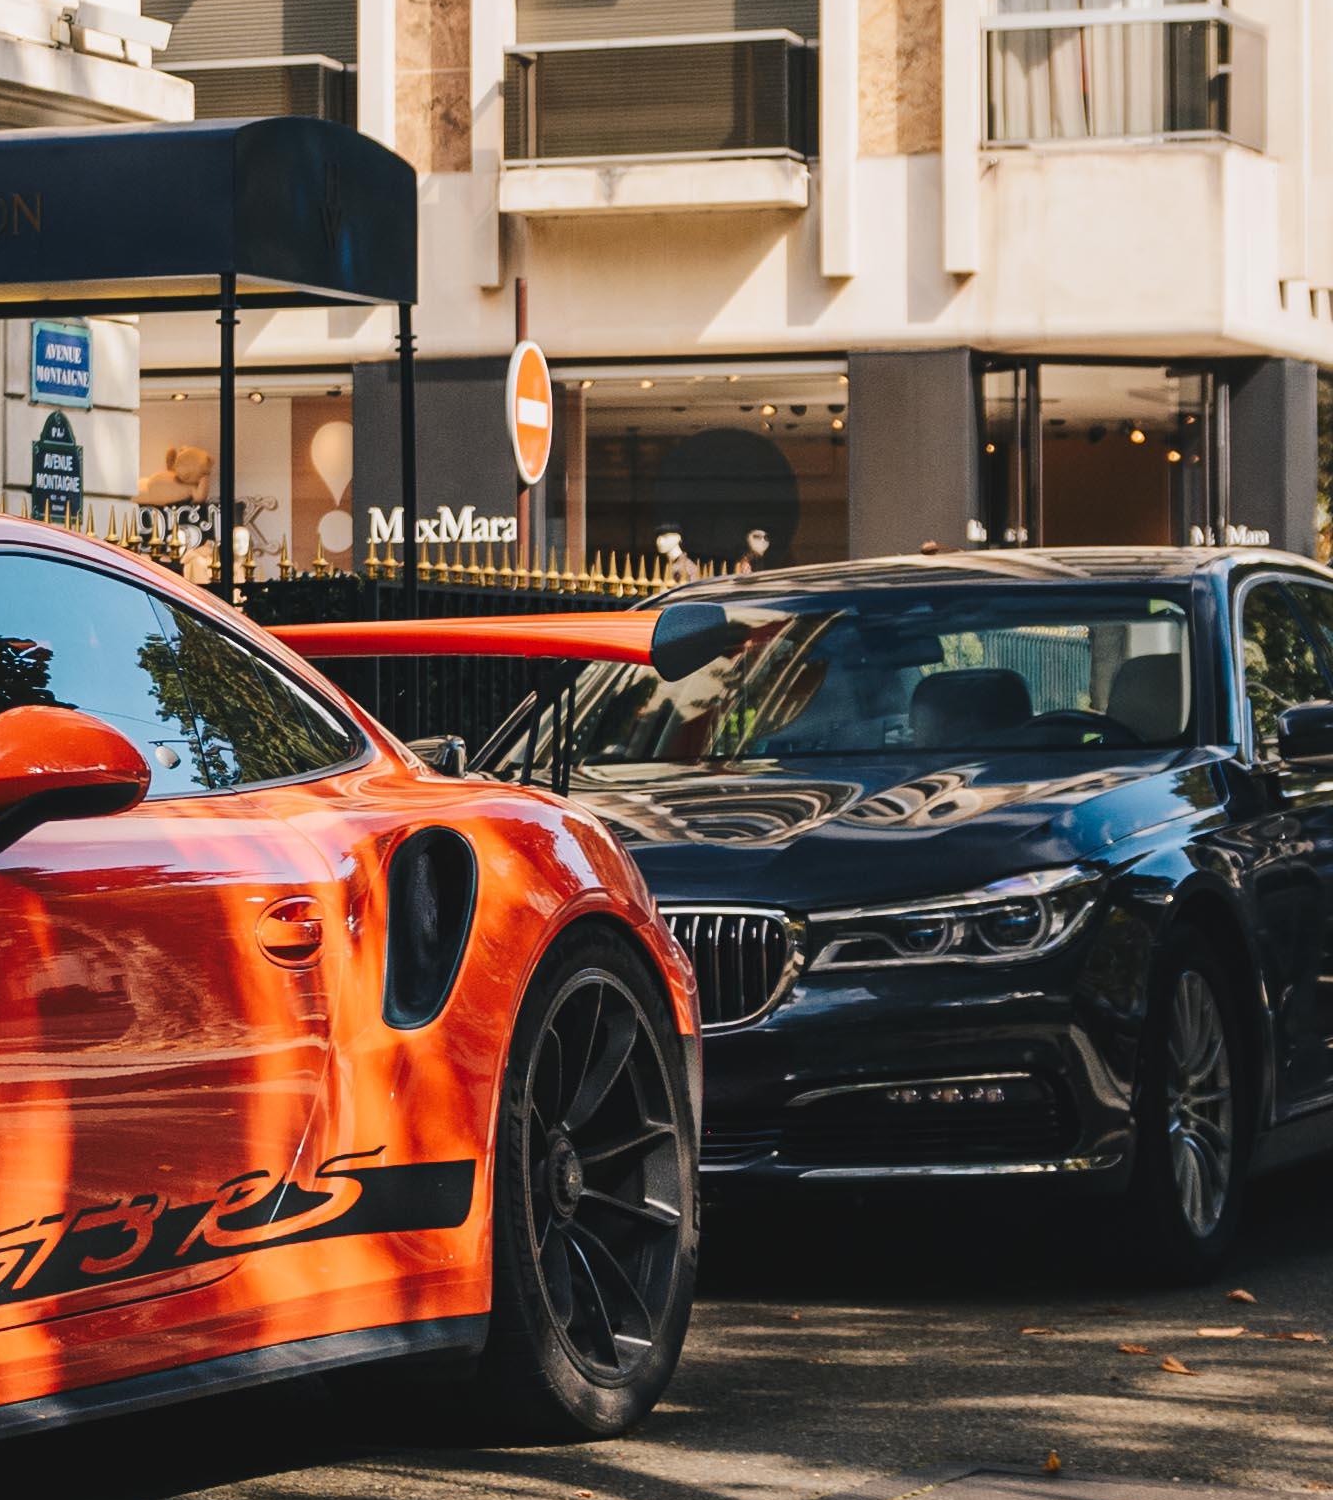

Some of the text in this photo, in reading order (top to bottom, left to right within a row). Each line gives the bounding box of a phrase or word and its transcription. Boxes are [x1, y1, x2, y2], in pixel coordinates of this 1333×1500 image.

[44, 343, 82, 364] AVENUE
[36, 365, 90, 388] MONTAIGNE
[43, 453, 73, 471] AVENUE
[36, 473, 80, 492] MONTAIGNE
